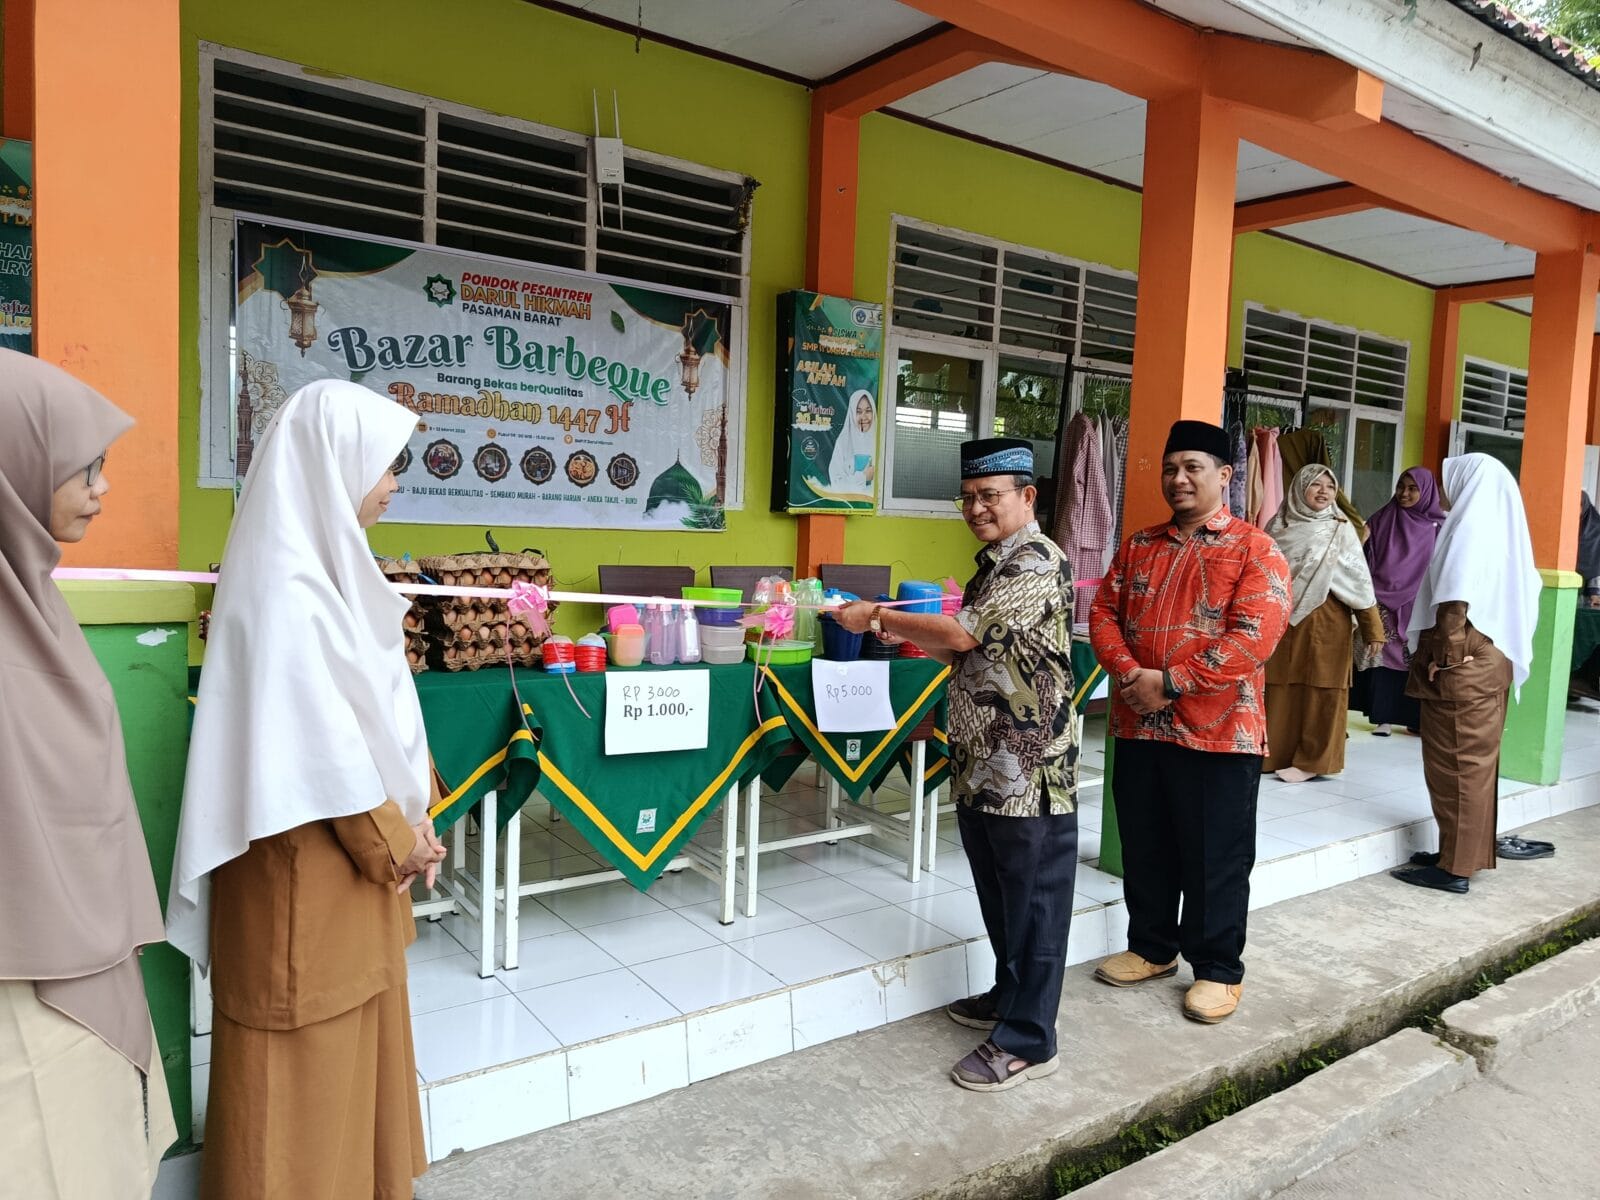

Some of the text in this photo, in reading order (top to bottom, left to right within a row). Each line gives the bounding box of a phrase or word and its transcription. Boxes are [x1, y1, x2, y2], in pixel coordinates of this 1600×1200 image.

[461, 272, 592, 303] PONDOK PESANTREN
[461, 283, 591, 320] DARUL HIKMAH
[462, 302, 561, 326] PASAMAN BARAT
[833, 327, 857, 338] SISWA
[802, 342, 818, 352] SMP
[327, 325, 672, 406] Bazar Barbeque
[795, 360, 836, 374] ASILAH
[437, 372, 584, 398] Barang Bekas berQualitas
[387, 381, 634, 435] Ramadhan 1447 H
[412, 486, 427, 495] BAJU
[428, 487, 447, 496] BEKAS
[448, 488, 483, 498] BERKUALITAS
[490, 490, 516, 499] SEMBAKO
[517, 491, 536, 500] MURAH
[542, 493, 562, 501] BARANG
[648, 686, 680, 700] 3000
[623, 702, 693, 720] Rp 1.000,-
